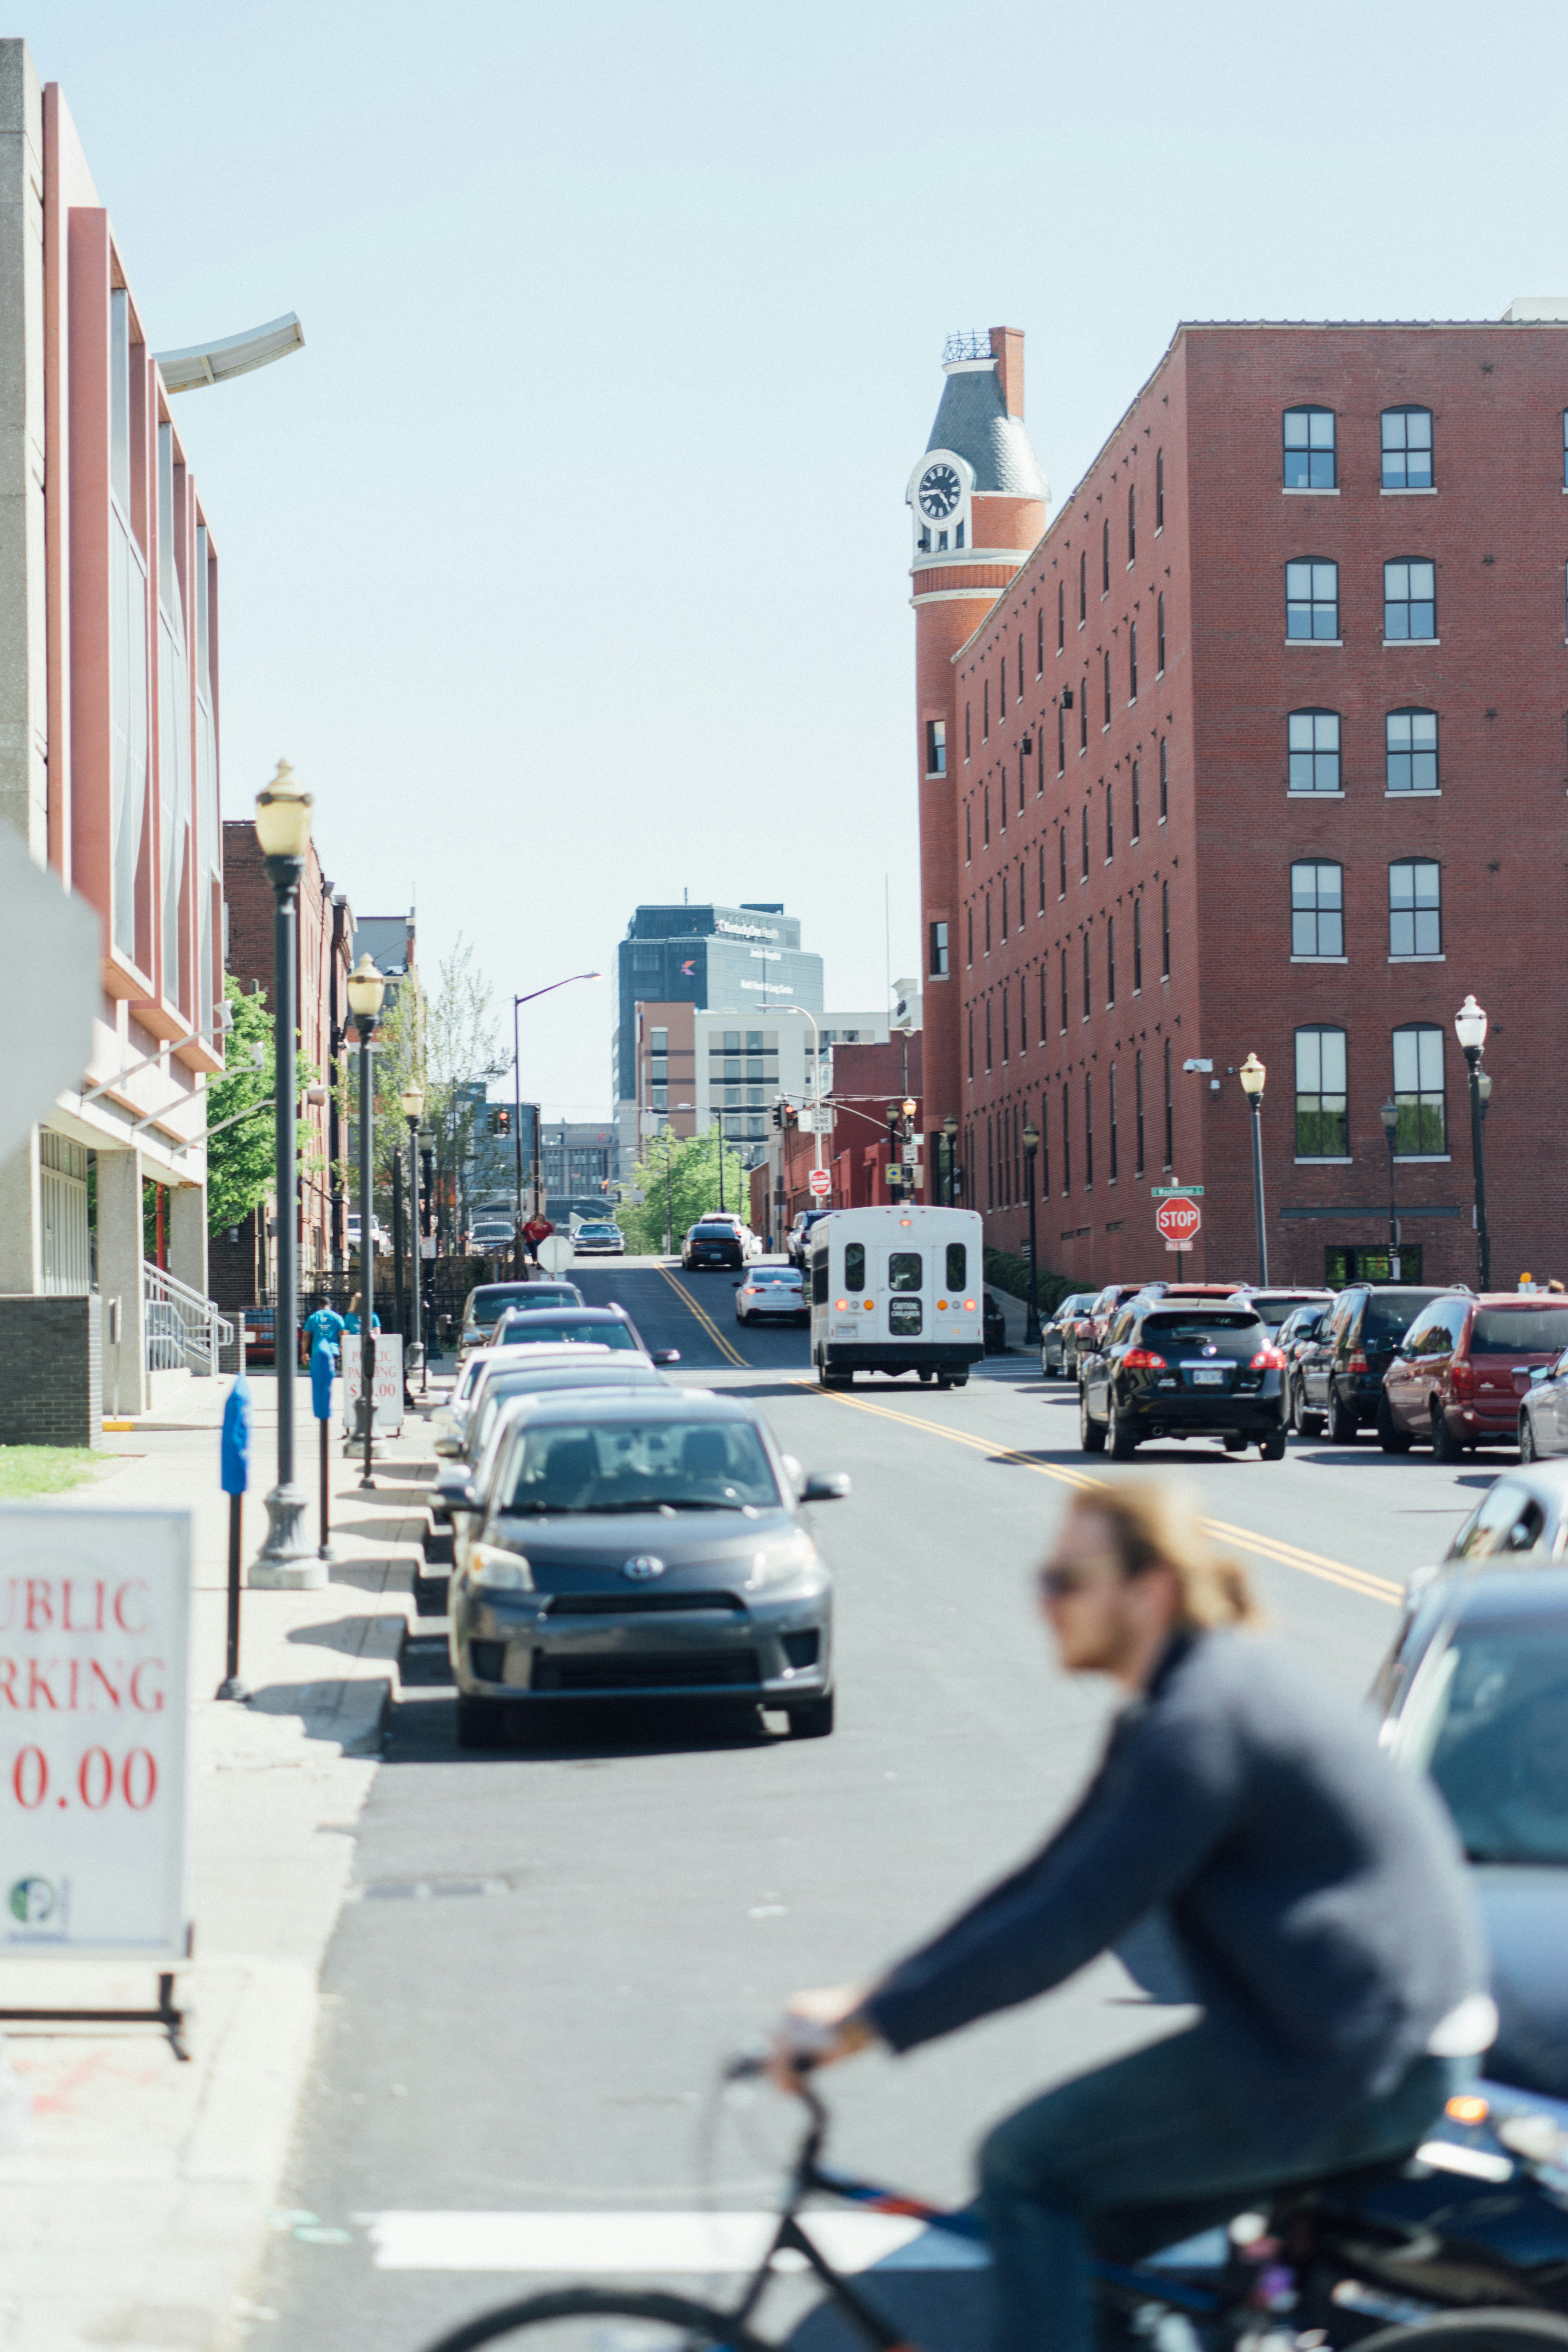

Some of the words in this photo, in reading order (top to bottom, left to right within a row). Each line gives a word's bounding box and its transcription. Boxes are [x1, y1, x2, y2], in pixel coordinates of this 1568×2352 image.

[1160, 1210, 1197, 1227] STOP
[352, 1350, 392, 1362] PLIC
[348, 1366, 396, 1377] PAING
